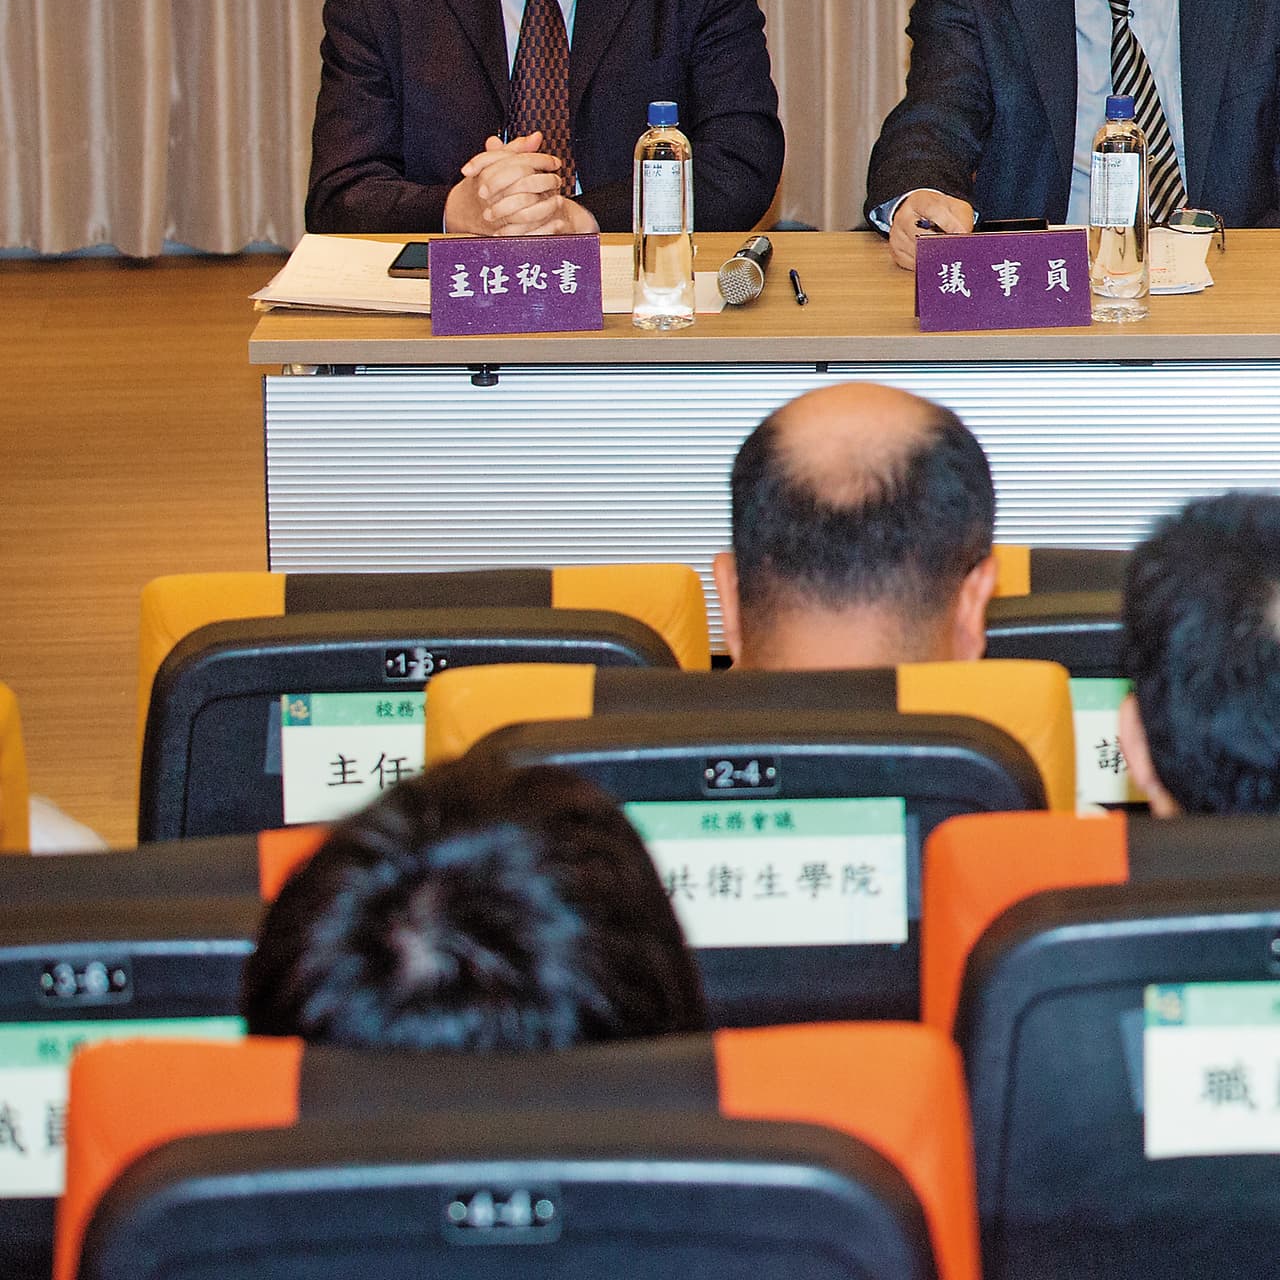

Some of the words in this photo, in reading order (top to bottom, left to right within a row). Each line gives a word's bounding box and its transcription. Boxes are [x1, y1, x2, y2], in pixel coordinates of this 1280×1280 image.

[448, 260, 582, 298] 主任秘書
[938, 258, 1071, 298] 議事員
[376, 700, 426, 718] 校務
[327, 752, 426, 791] 主任
[714, 759, 761, 788] 2-4
